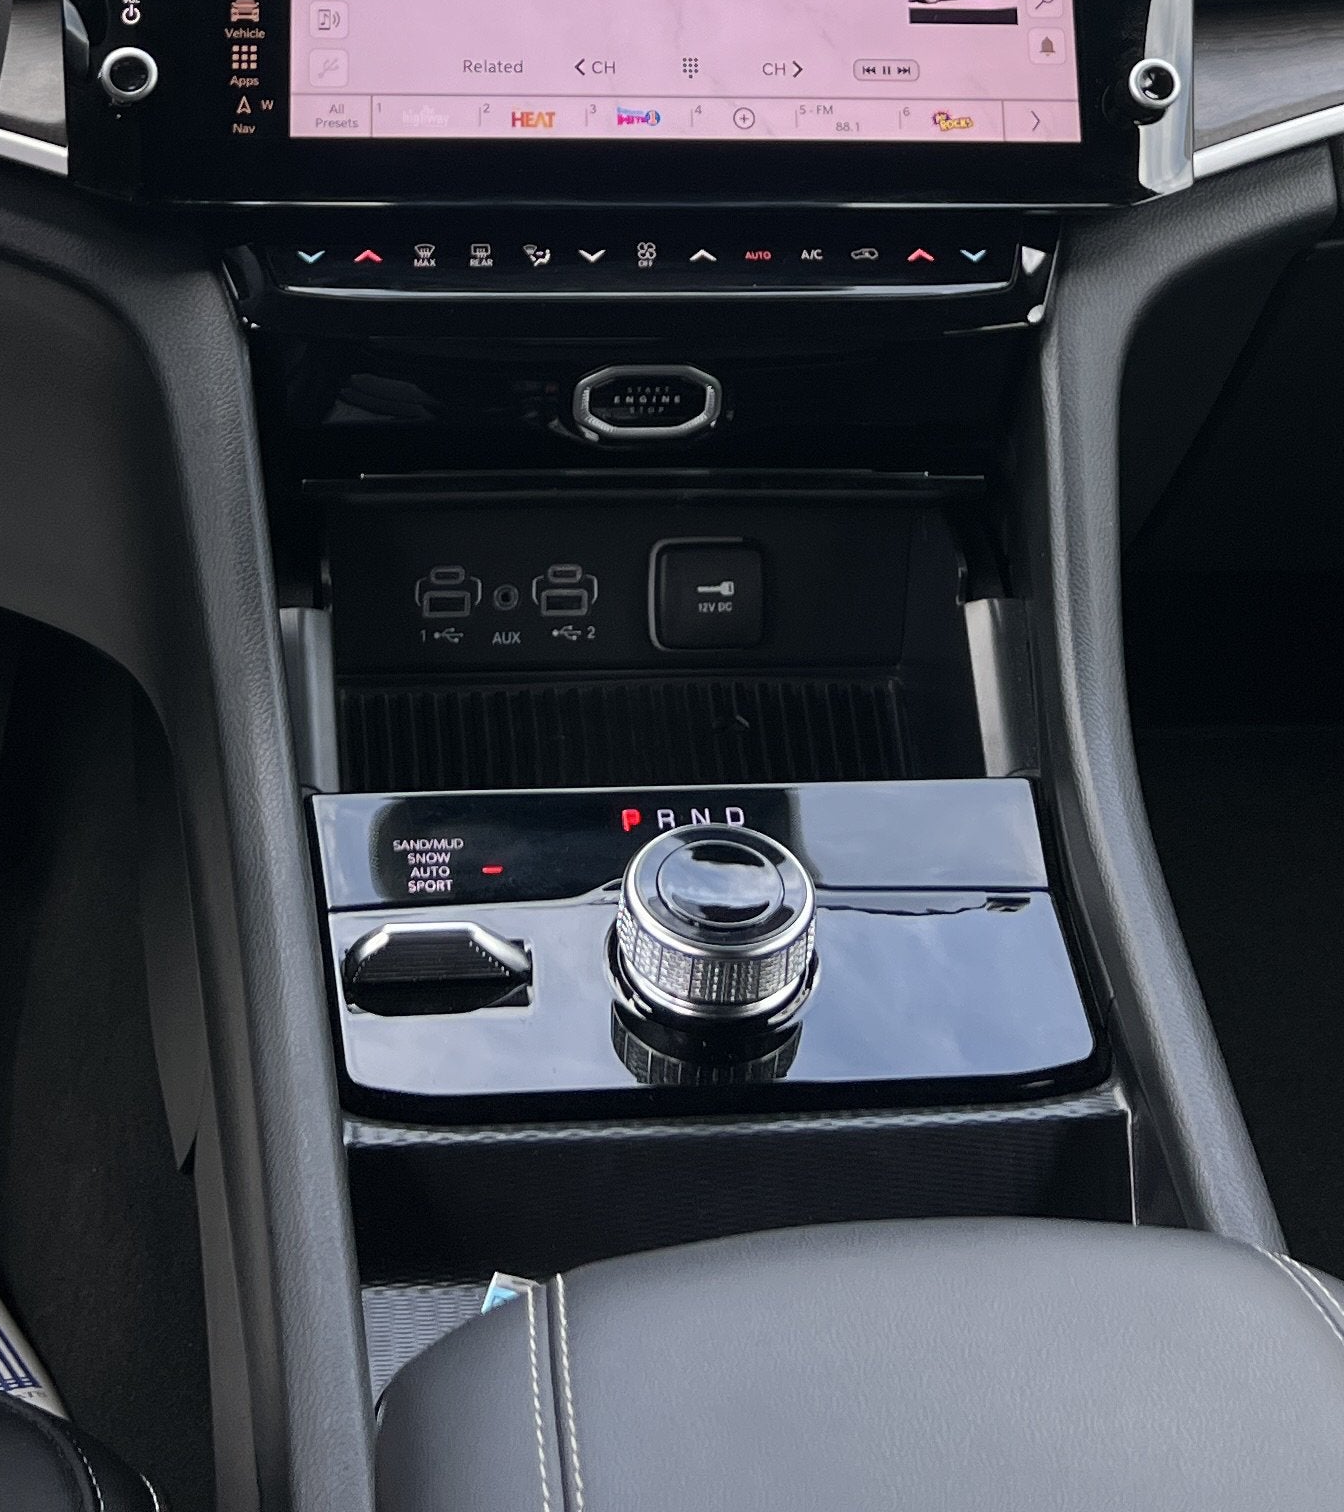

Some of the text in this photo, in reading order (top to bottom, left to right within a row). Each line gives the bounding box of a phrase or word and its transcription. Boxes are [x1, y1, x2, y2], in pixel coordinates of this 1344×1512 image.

[224, 27, 266, 39] Vehicle
[462, 59, 524, 75] Related
[591, 60, 617, 75] CH
[761, 61, 787, 77] CH
[229, 75, 260, 88] Apps
[260, 99, 275, 110] W
[329, 103, 345, 115] All
[376, 103, 382, 113] 1
[482, 103, 491, 113] 2
[589, 104, 597, 114] 3
[694, 104, 703, 115] 4
[816, 105, 834, 116] FM
[902, 106, 911, 117] 6
[314, 117, 360, 130] Presets
[511, 111, 557, 128] HEAT
[232, 122, 256, 134] Nav
[834, 121, 861, 133] 88.1
[745, 250, 772, 260] AUTO
[801, 248, 824, 260] A/C
[413, 258, 436, 267] MAX
[469, 258, 494, 267] REAR
[638, 259, 654, 268] OFF
[627, 386, 670, 394] START
[613, 395, 682, 405] ENGINE
[629, 406, 665, 414] STOP
[698, 601, 734, 613] 12V DC
[420, 629, 427, 643] 1
[492, 631, 522, 645] AUX
[586, 626, 596, 639] 2
[621, 806, 746, 832] P R N D
[392, 837, 465, 852] SAND/MUD
[407, 851, 452, 864] SNOW
[410, 865, 451, 879] AUTO
[407, 878, 453, 893] SPORT
